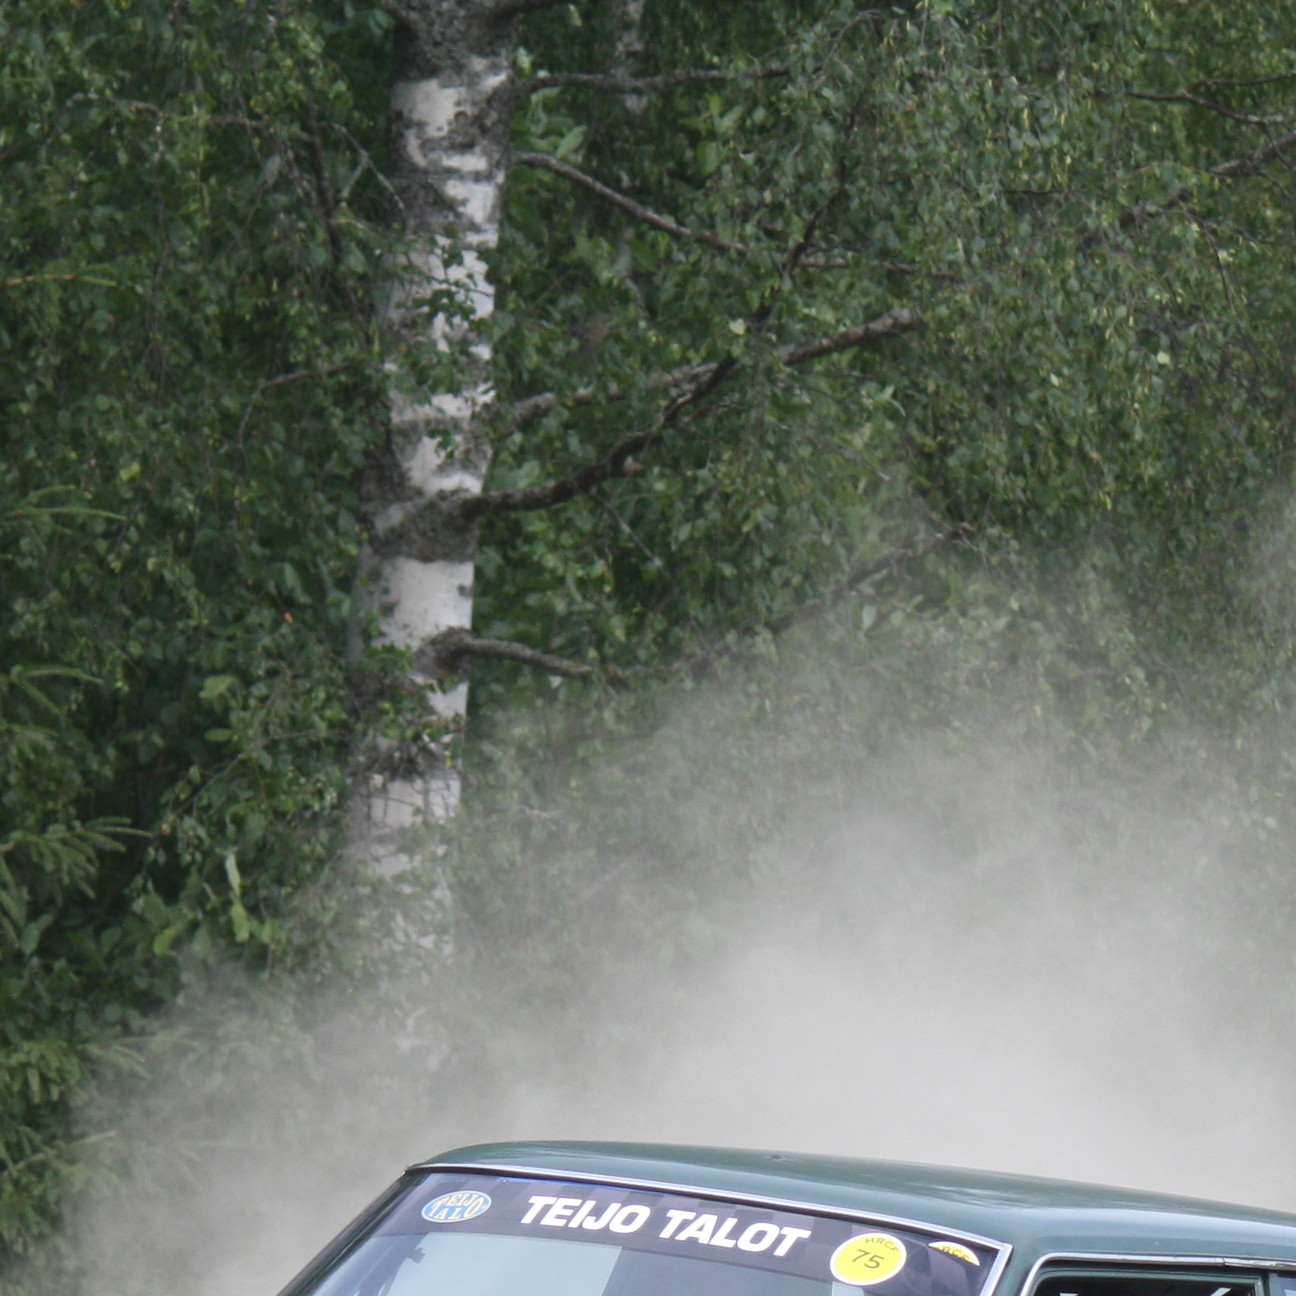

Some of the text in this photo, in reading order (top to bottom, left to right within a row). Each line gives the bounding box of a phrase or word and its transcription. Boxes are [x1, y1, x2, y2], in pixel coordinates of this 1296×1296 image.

[520, 1195, 811, 1257] TEIJO TALOT
[852, 1249, 885, 1269] 75
